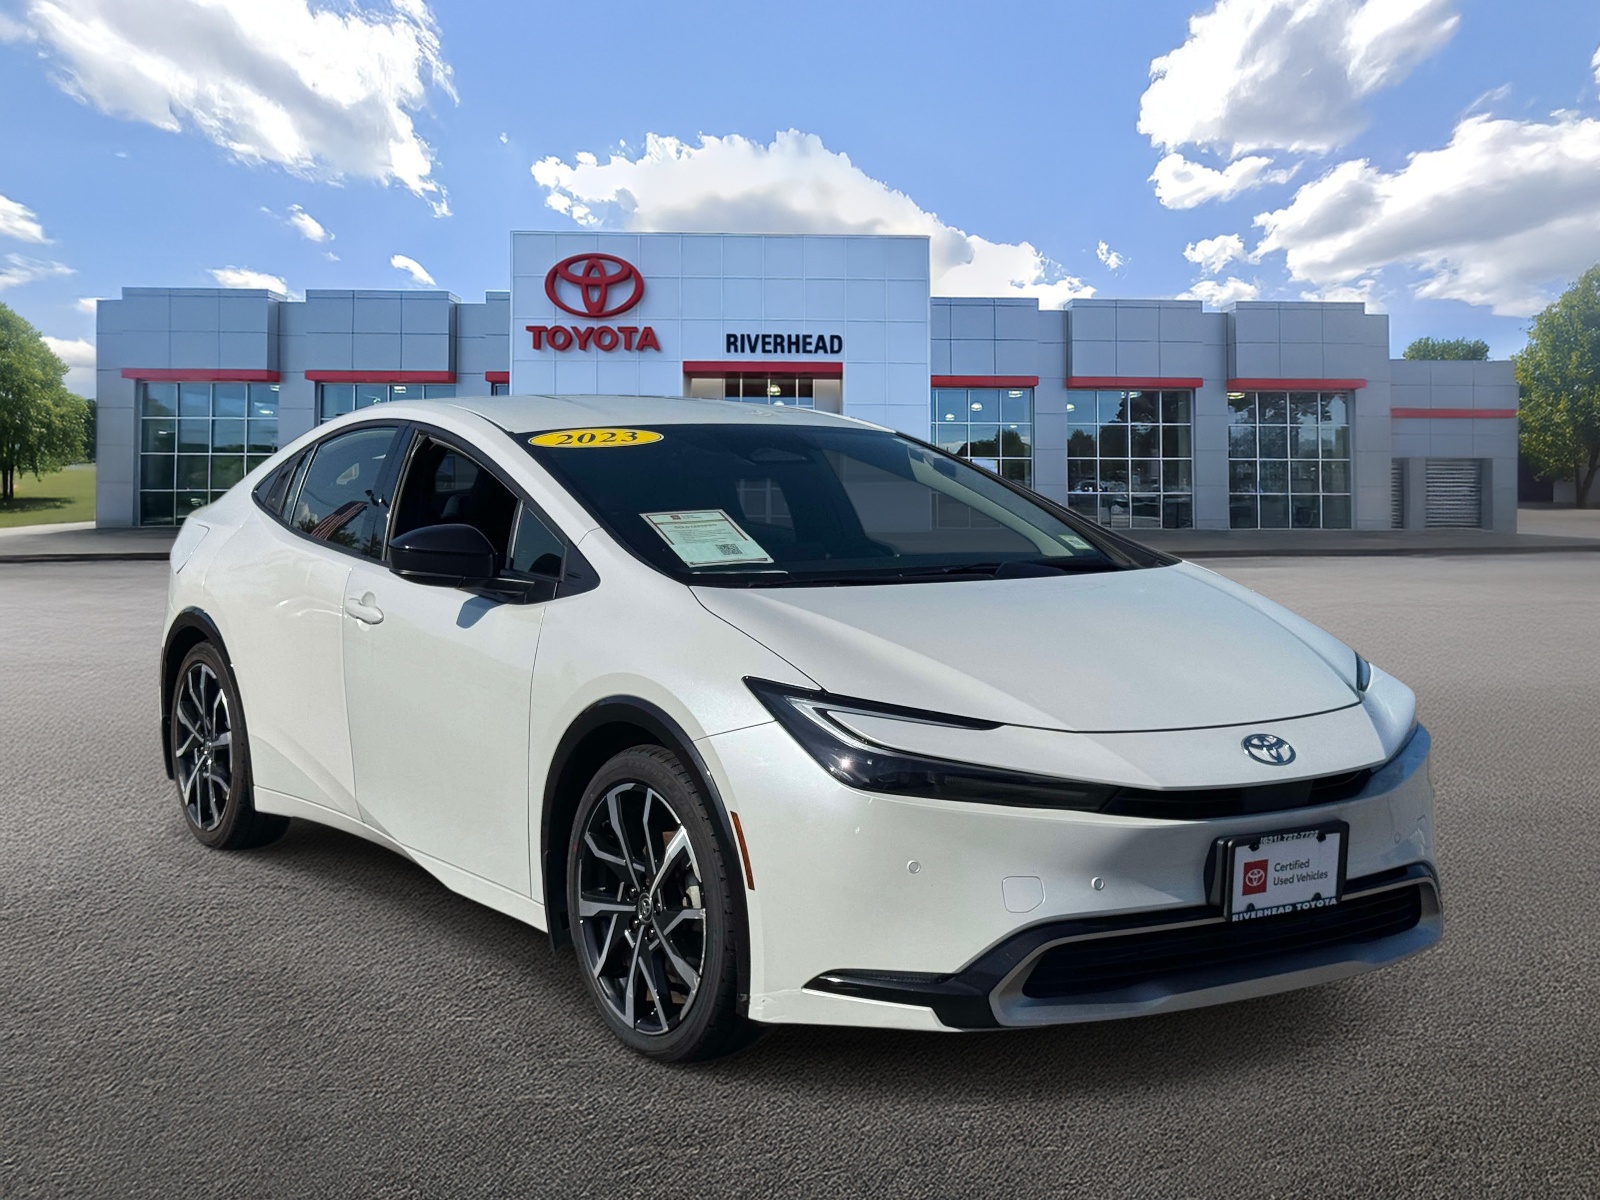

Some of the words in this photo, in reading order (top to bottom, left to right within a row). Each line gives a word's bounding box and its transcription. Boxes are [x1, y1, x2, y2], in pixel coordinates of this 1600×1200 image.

[526, 325, 661, 352] TOYOTA
[726, 333, 843, 354] RIVERHEAD
[555, 431, 639, 446] 2023
[1274, 859, 1310, 872] Certified
[1273, 873, 1294, 886] Used
[1296, 871, 1328, 882] Vehicles
[1232, 906, 1292, 922] RIVERHEAD
[1296, 898, 1337, 910] TOYOTA
